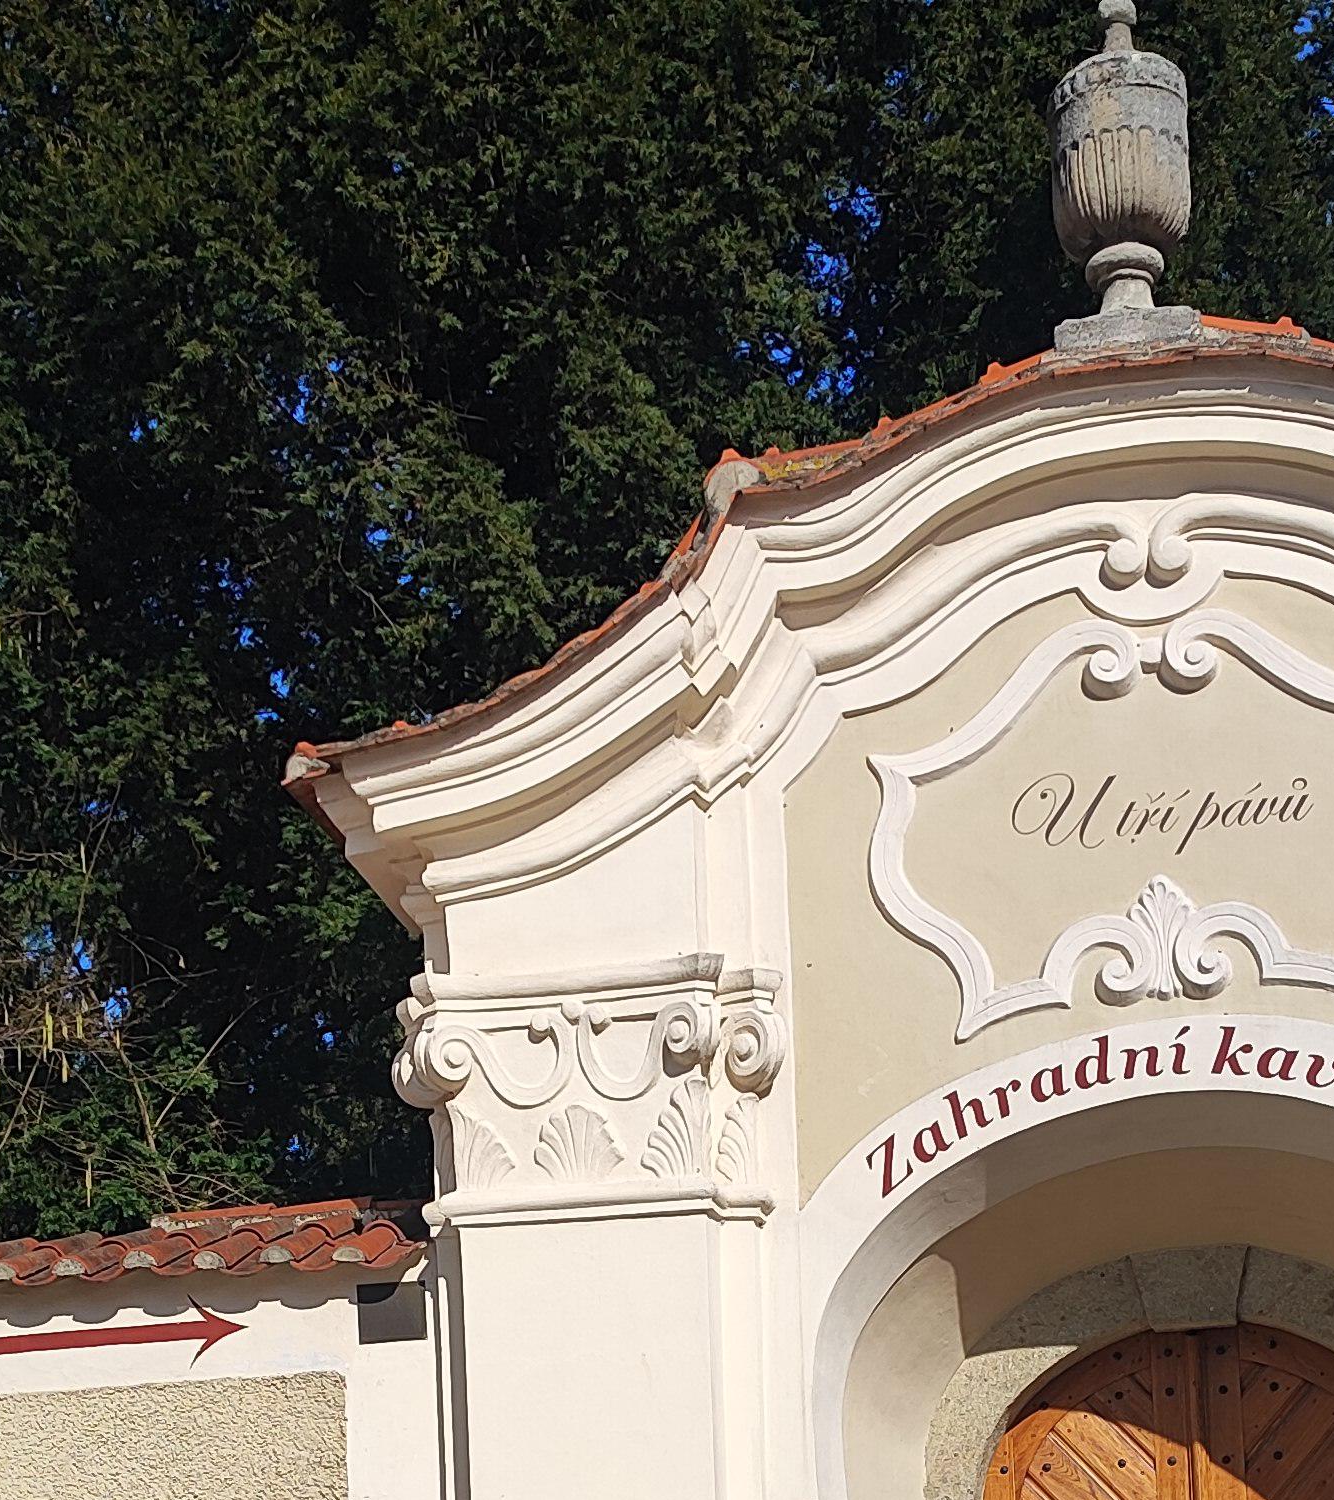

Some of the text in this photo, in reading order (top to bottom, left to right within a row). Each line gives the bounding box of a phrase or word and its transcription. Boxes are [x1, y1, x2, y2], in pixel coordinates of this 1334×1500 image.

[1011, 773, 1315, 856] U tří pávů
[866, 1026, 1193, 1200] Zahradní
